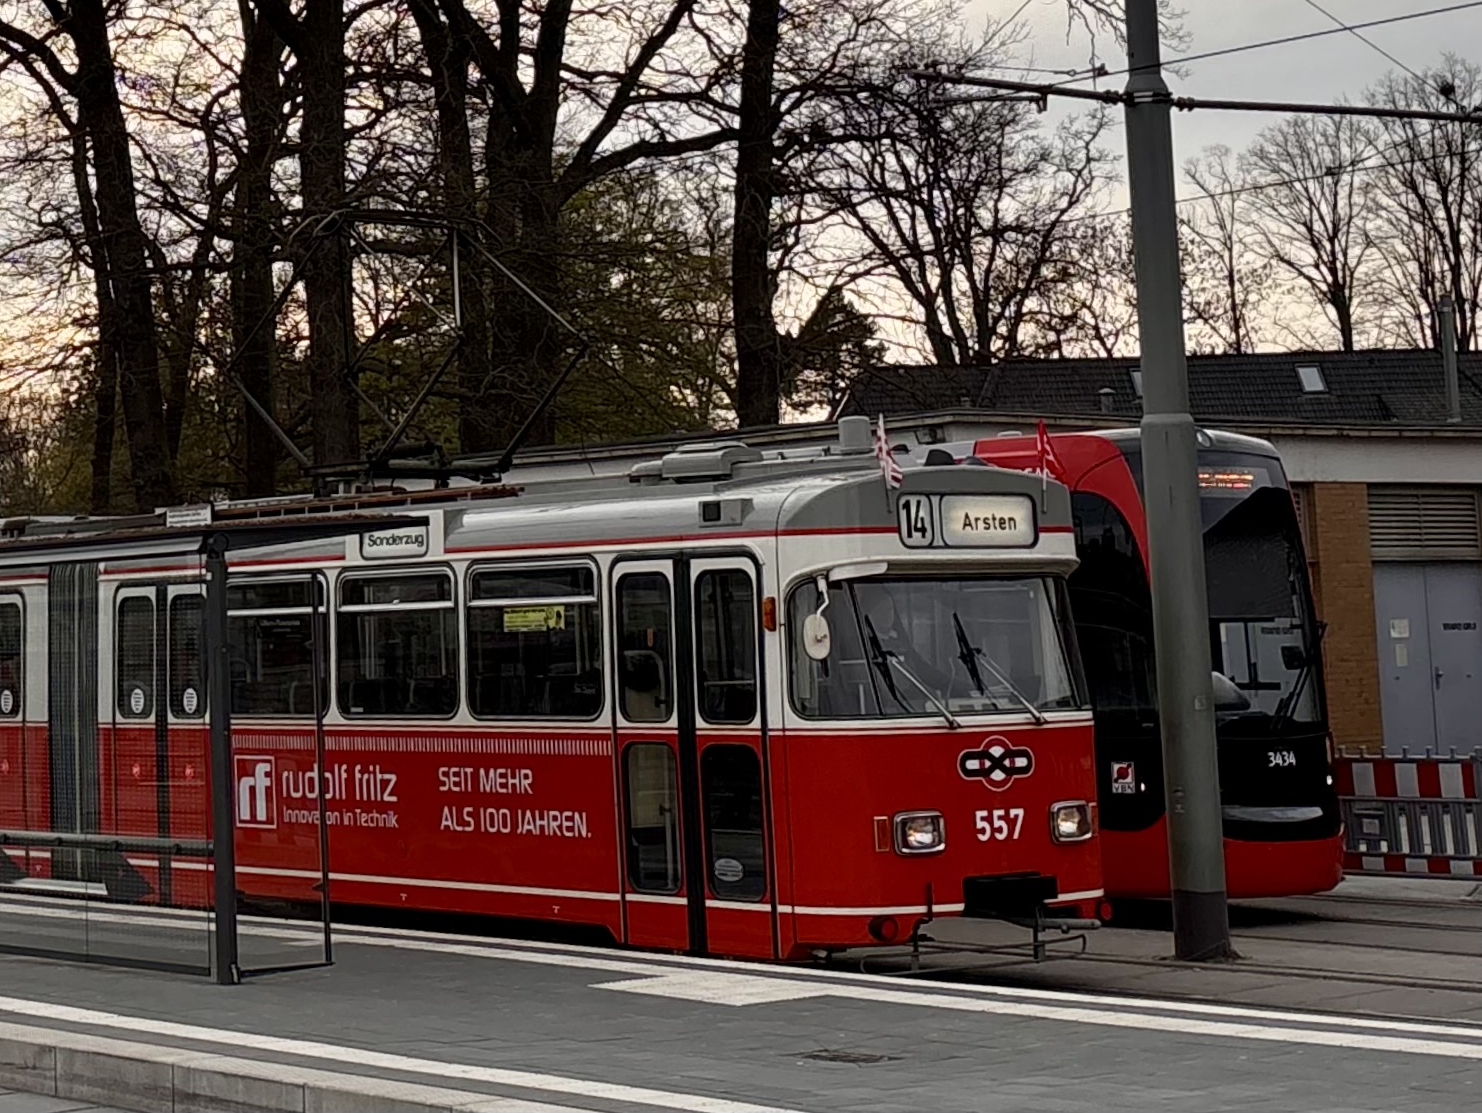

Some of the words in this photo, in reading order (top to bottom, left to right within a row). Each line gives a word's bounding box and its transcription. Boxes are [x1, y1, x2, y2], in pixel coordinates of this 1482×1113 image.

[902, 499, 928, 539] 14
[962, 512, 1017, 531] Arsten
[368, 533, 424, 548] Sonderzug
[1268, 751, 1297, 767] 3434
[354, 764, 398, 802] fritz
[438, 767, 474, 792] SEIT
[479, 767, 533, 795] MEHR
[283, 805, 340, 826] Innovaon
[343, 808, 354, 826] in
[355, 808, 399, 829] Technik
[440, 805, 475, 832] ALS
[480, 807, 511, 834] 100
[517, 809, 592, 838] JAHREN.
[975, 808, 1025, 841] 557
